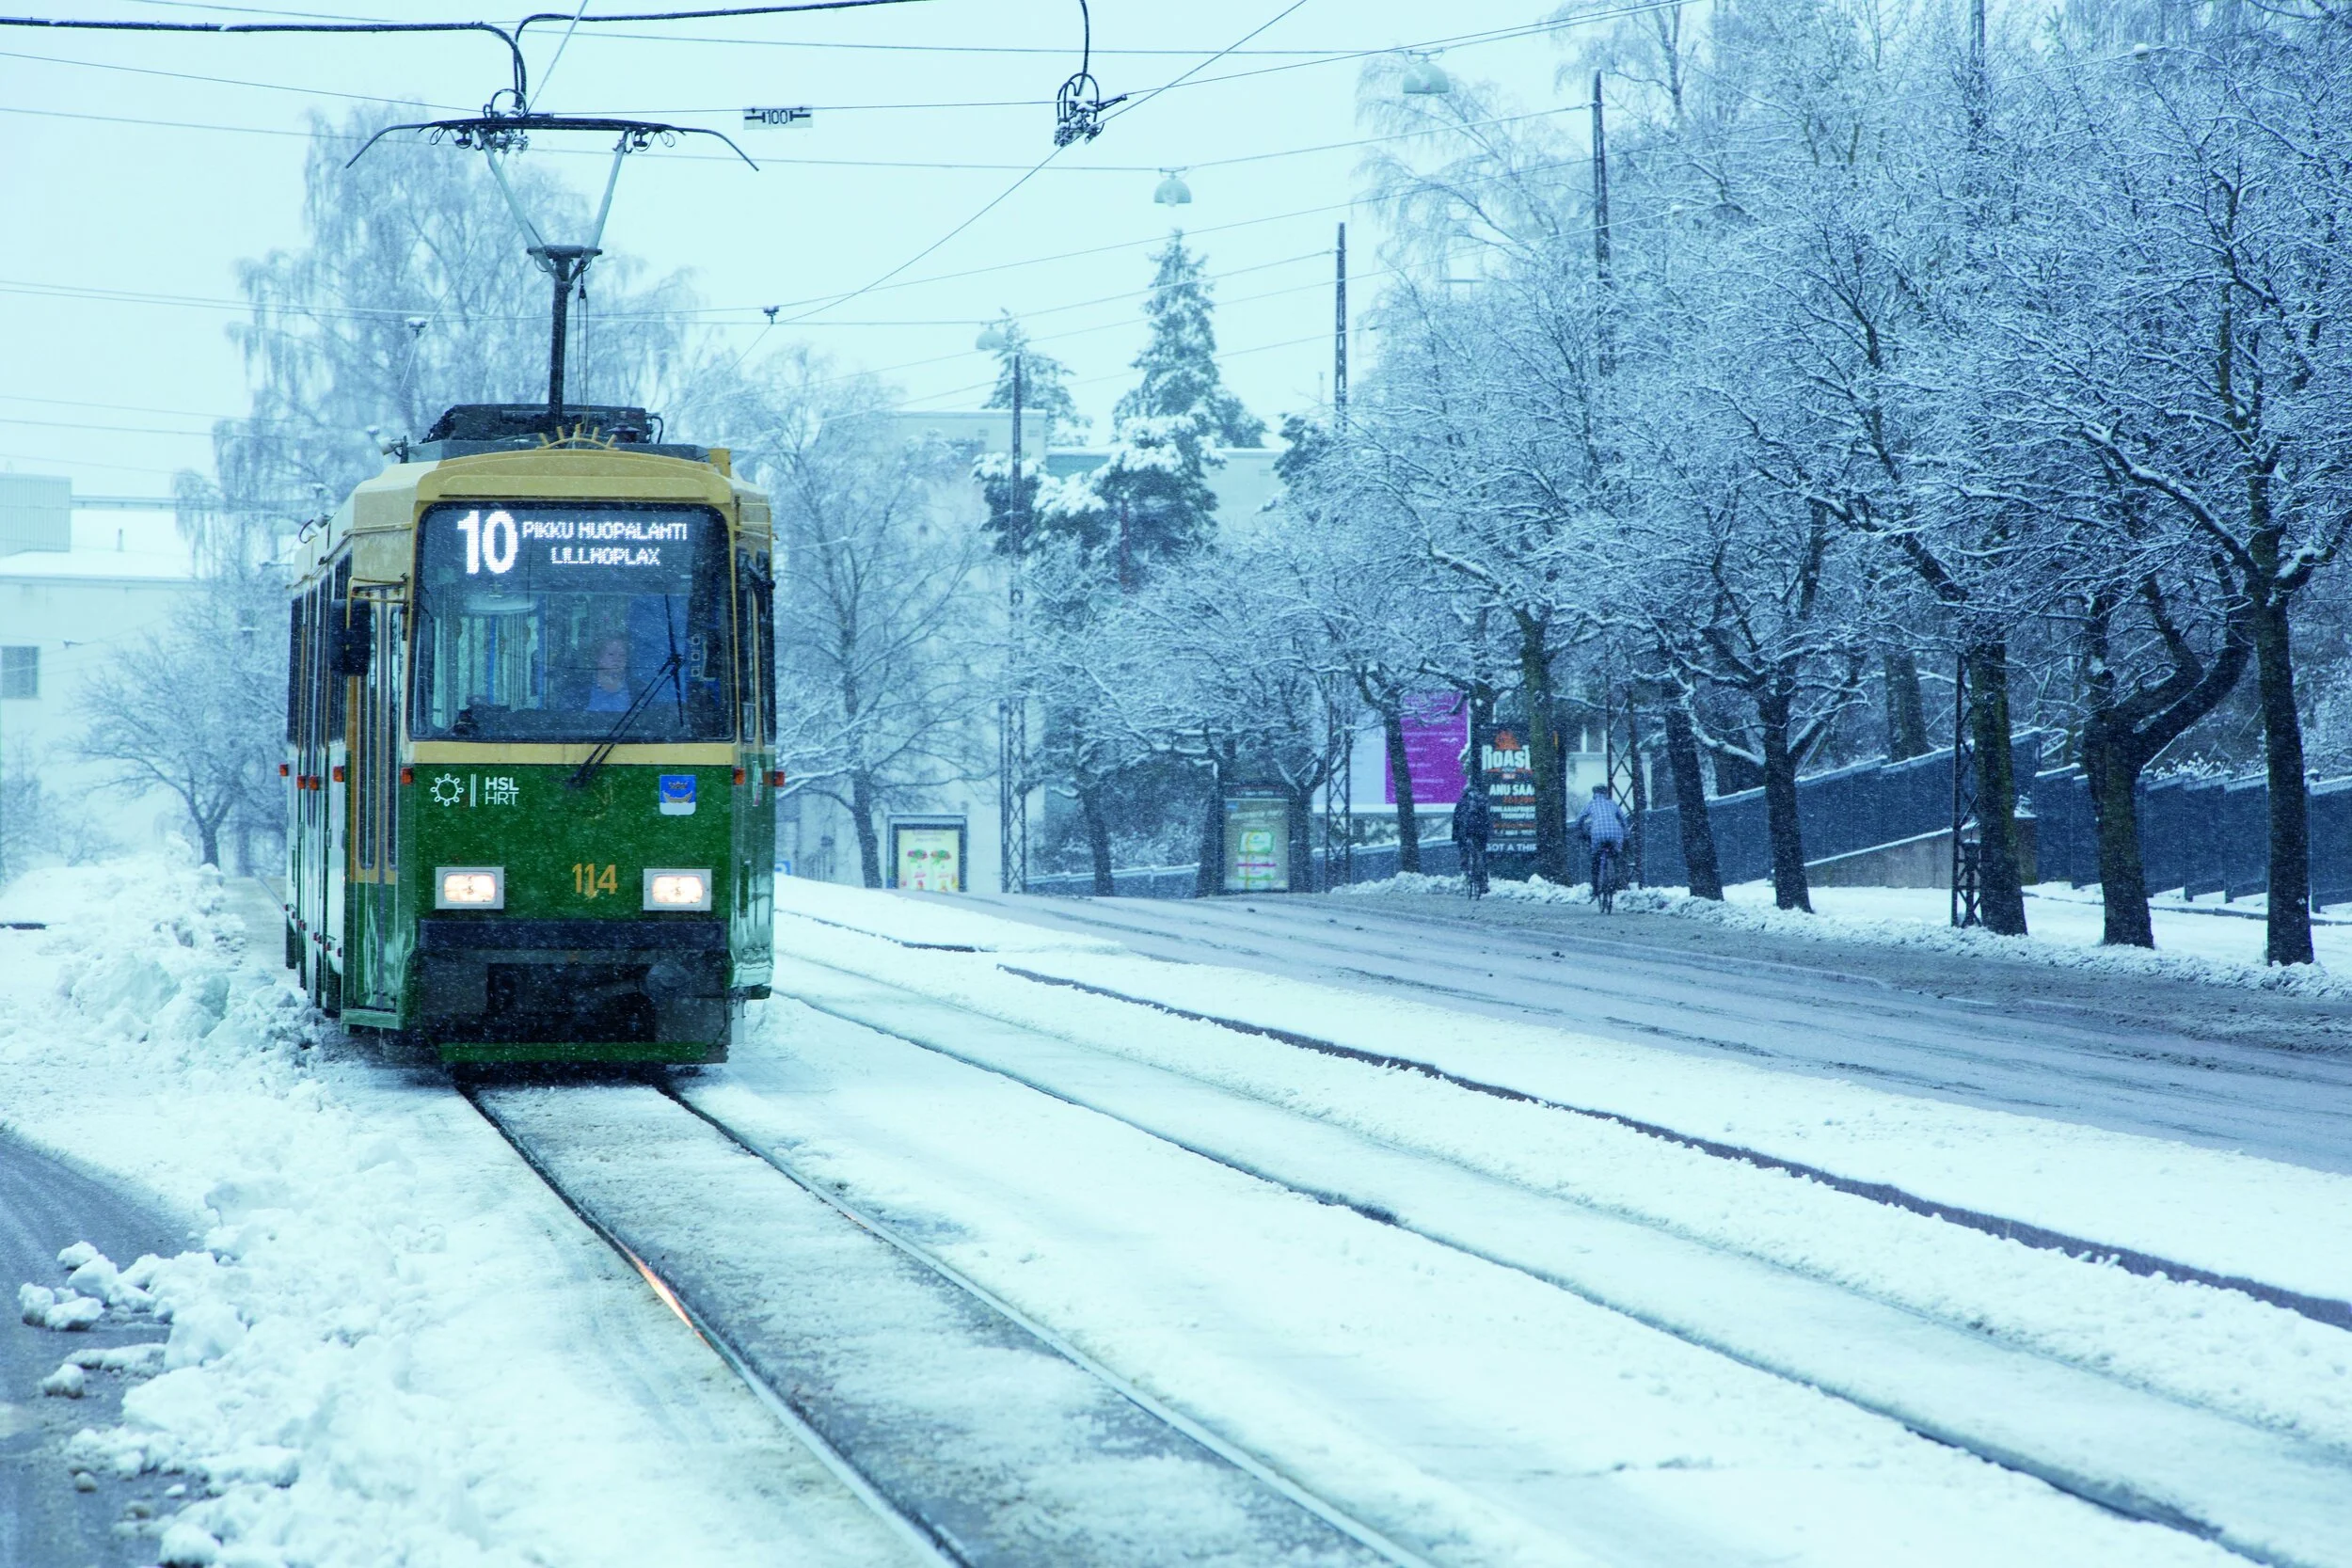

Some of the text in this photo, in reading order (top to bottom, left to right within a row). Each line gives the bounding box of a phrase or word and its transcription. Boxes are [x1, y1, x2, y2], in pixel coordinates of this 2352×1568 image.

[767, 110, 788, 124] 100
[522, 521, 688, 541] PIKKU HUOPALAHTI
[457, 511, 517, 575] 10
[550, 547, 660, 564] LILLHOPLAX
[485, 777, 519, 791] HSL
[485, 791, 519, 805] HRT
[572, 863, 618, 895] 114
